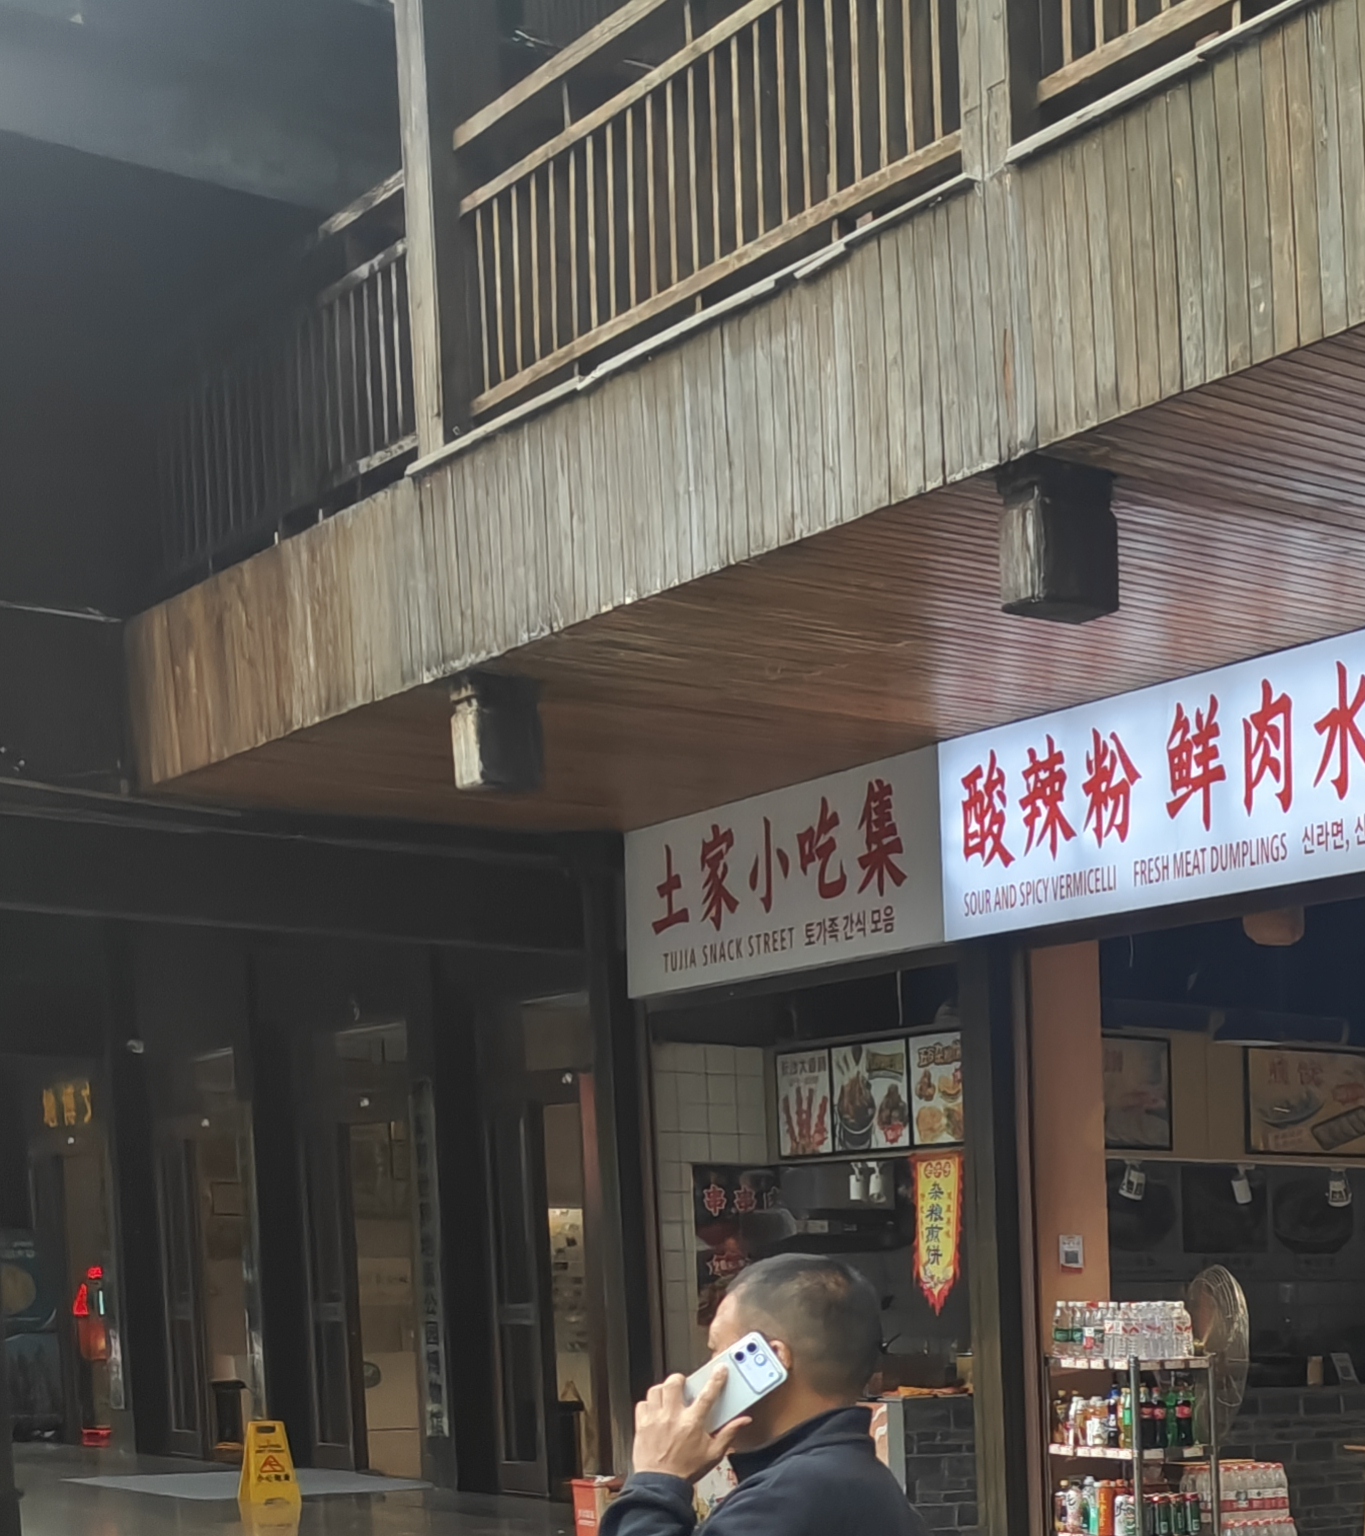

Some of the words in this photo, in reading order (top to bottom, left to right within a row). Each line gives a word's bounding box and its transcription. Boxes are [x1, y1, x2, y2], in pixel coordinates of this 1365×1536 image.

[960, 726, 1142, 868] 酸辣粉
[651, 778, 908, 935] 土家小吃集
[1302, 818, 1350, 854] 신라면,
[964, 889, 991, 917] SOUR
[994, 885, 1017, 911] AND
[1019, 877, 1049, 907] SPICY
[1051, 865, 1117, 901] VERMICELLI
[1133, 855, 1169, 887] FRESH
[1172, 847, 1207, 880] MEAT
[1210, 833, 1288, 874] DUMPLINGS
[663, 945, 697, 973] TUJIA
[702, 938, 743, 967] SNACK
[748, 927, 795, 957] STREET
[804, 914, 839, 947] 토가족
[842, 910, 867, 941] 간식
[870, 905, 896, 934] 모음
